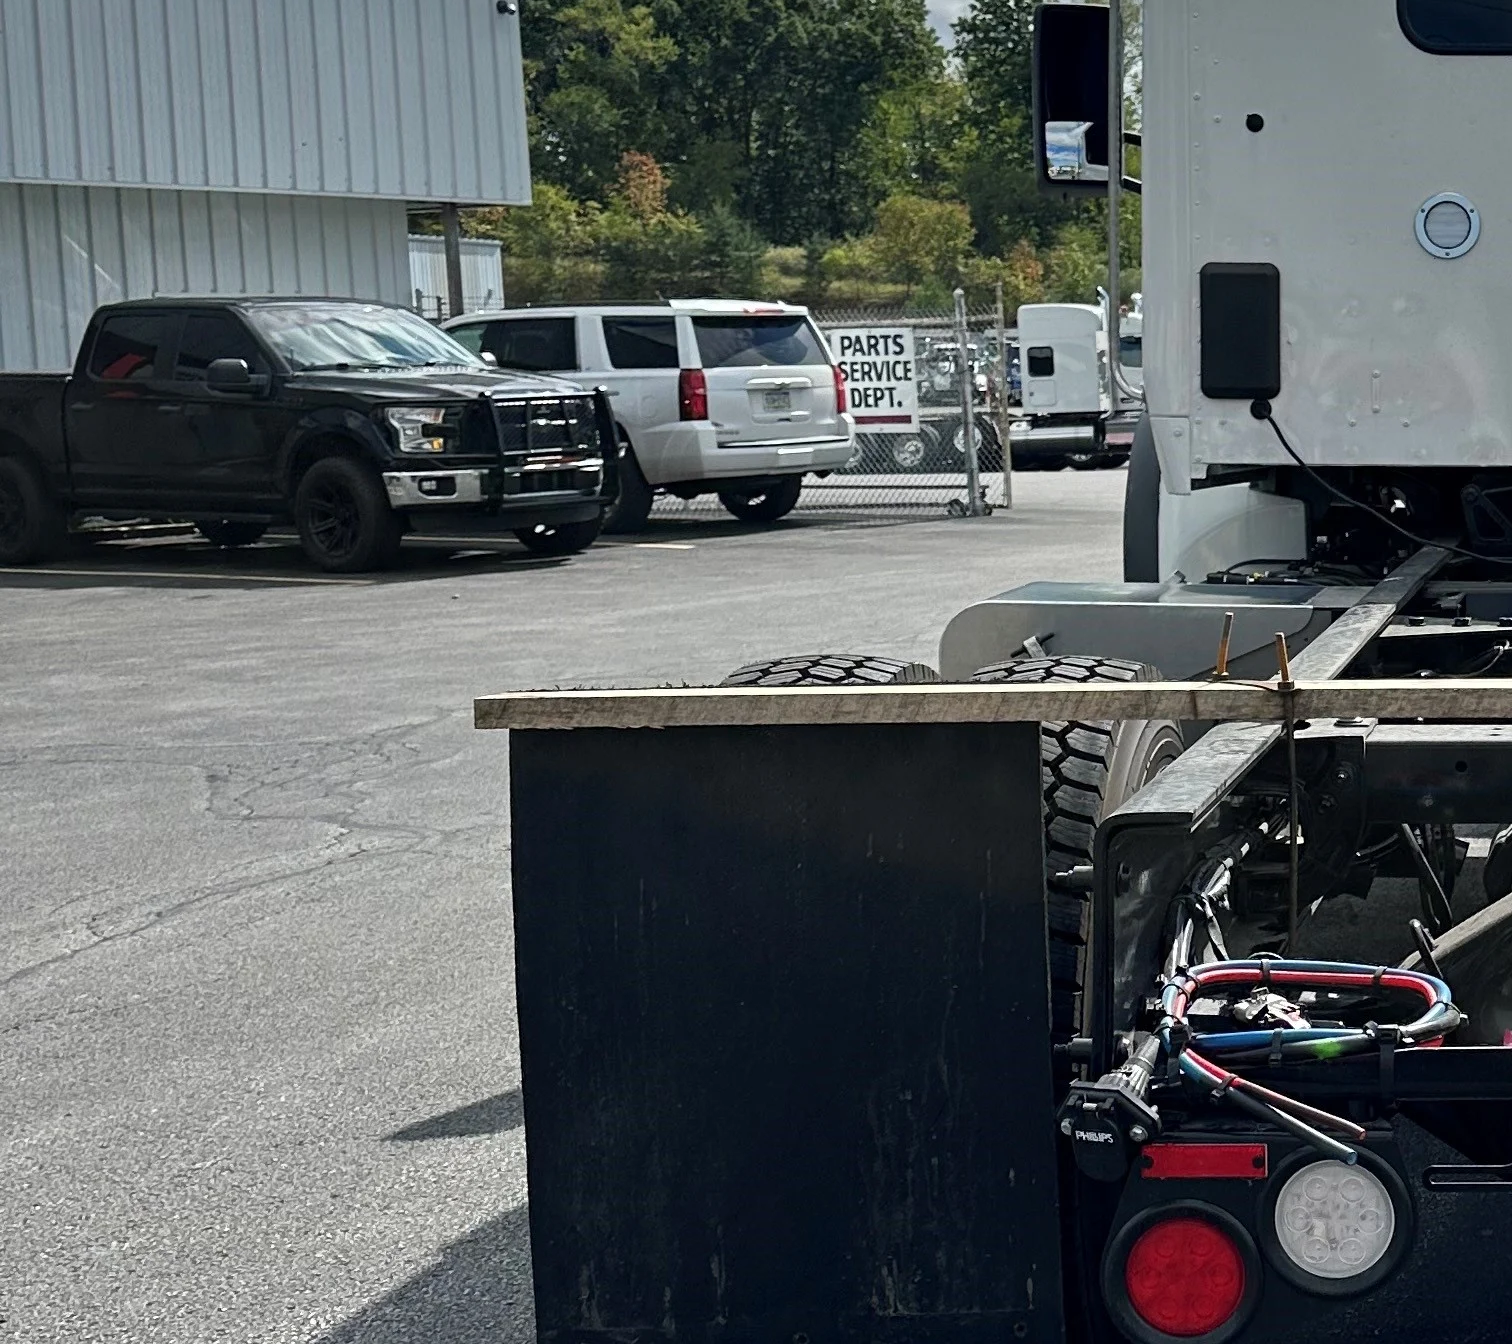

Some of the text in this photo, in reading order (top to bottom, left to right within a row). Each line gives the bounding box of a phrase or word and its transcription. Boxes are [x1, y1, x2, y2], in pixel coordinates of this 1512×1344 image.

[840, 334, 905, 357] PARTS
[837, 360, 913, 382] SERVICE
[850, 387, 903, 408] DEPT.
